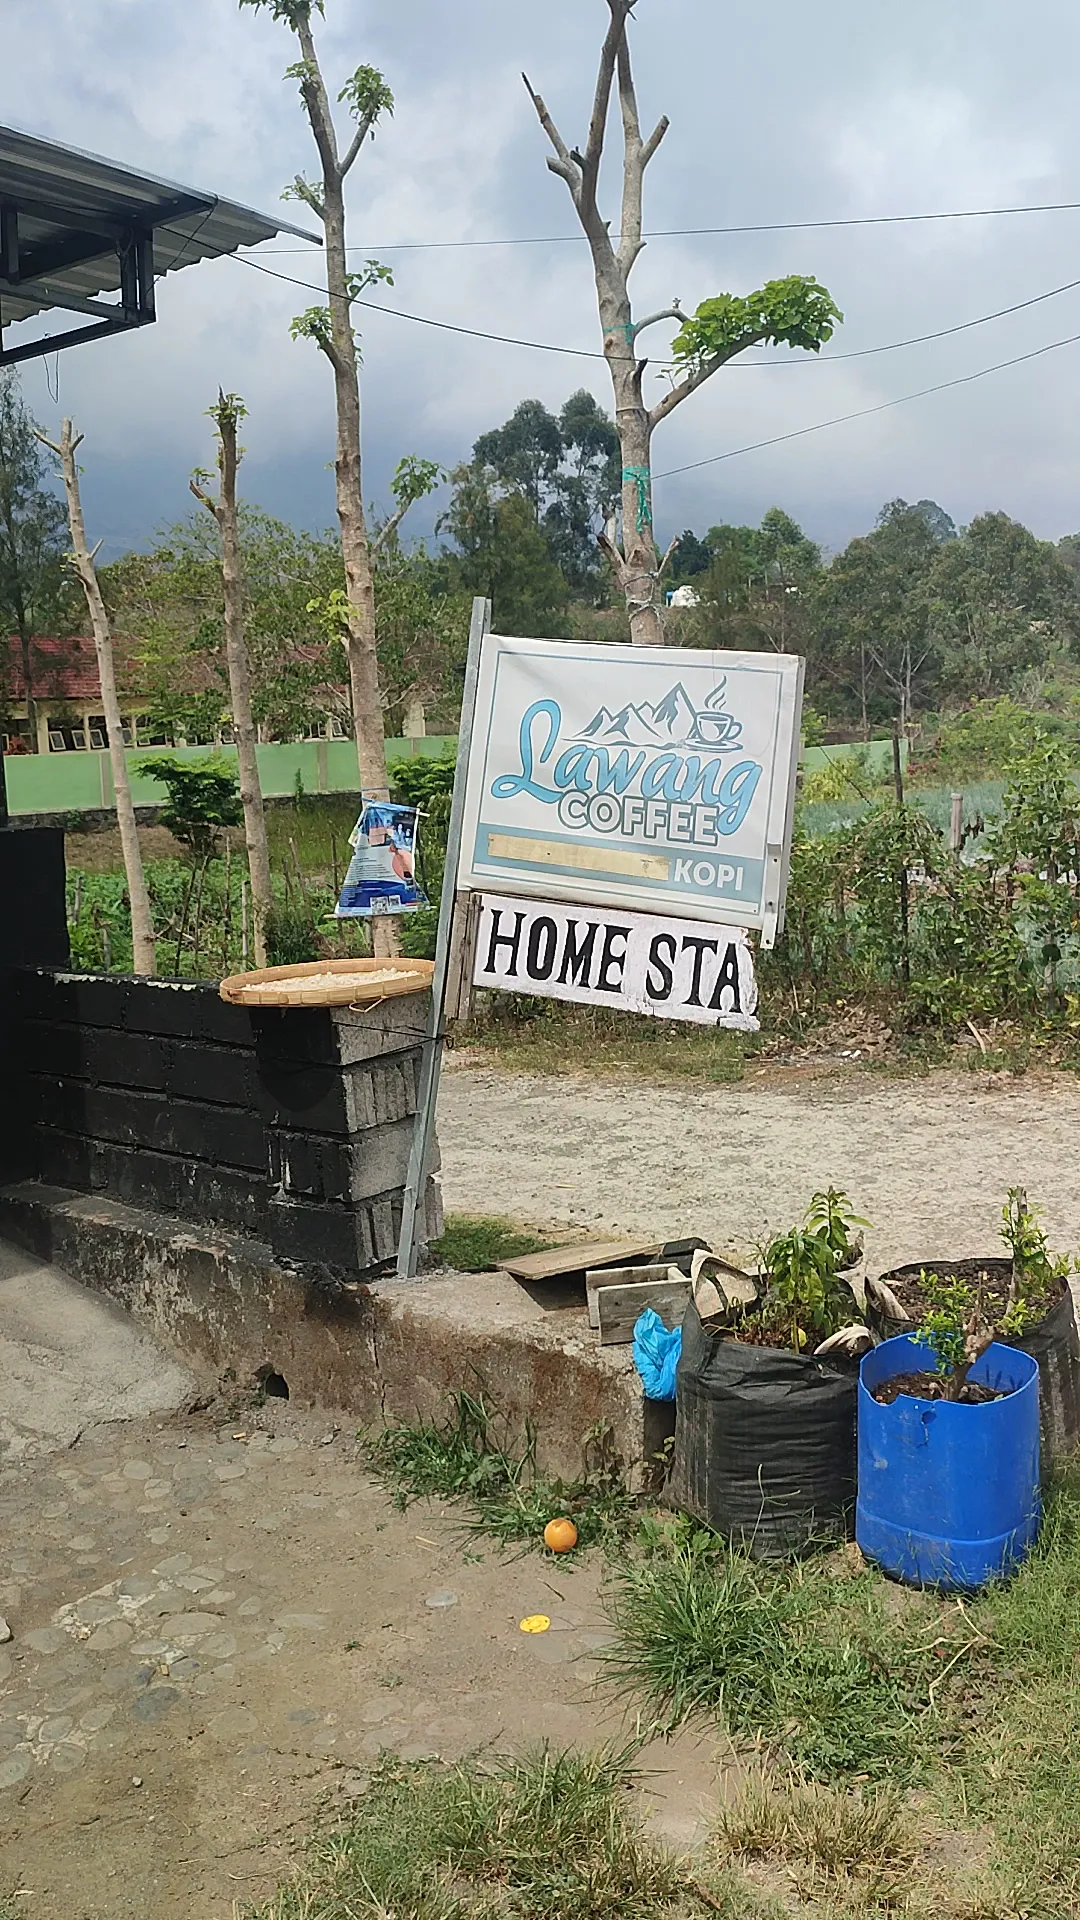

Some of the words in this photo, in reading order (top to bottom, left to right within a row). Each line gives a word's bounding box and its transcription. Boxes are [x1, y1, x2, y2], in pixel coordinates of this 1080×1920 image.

[490, 699, 763, 835] Lawang
[557, 791, 720, 847] COFFEE
[673, 858, 743, 892] KOPI
[483, 909, 634, 993] HOME
[645, 932, 758, 1016] STA
